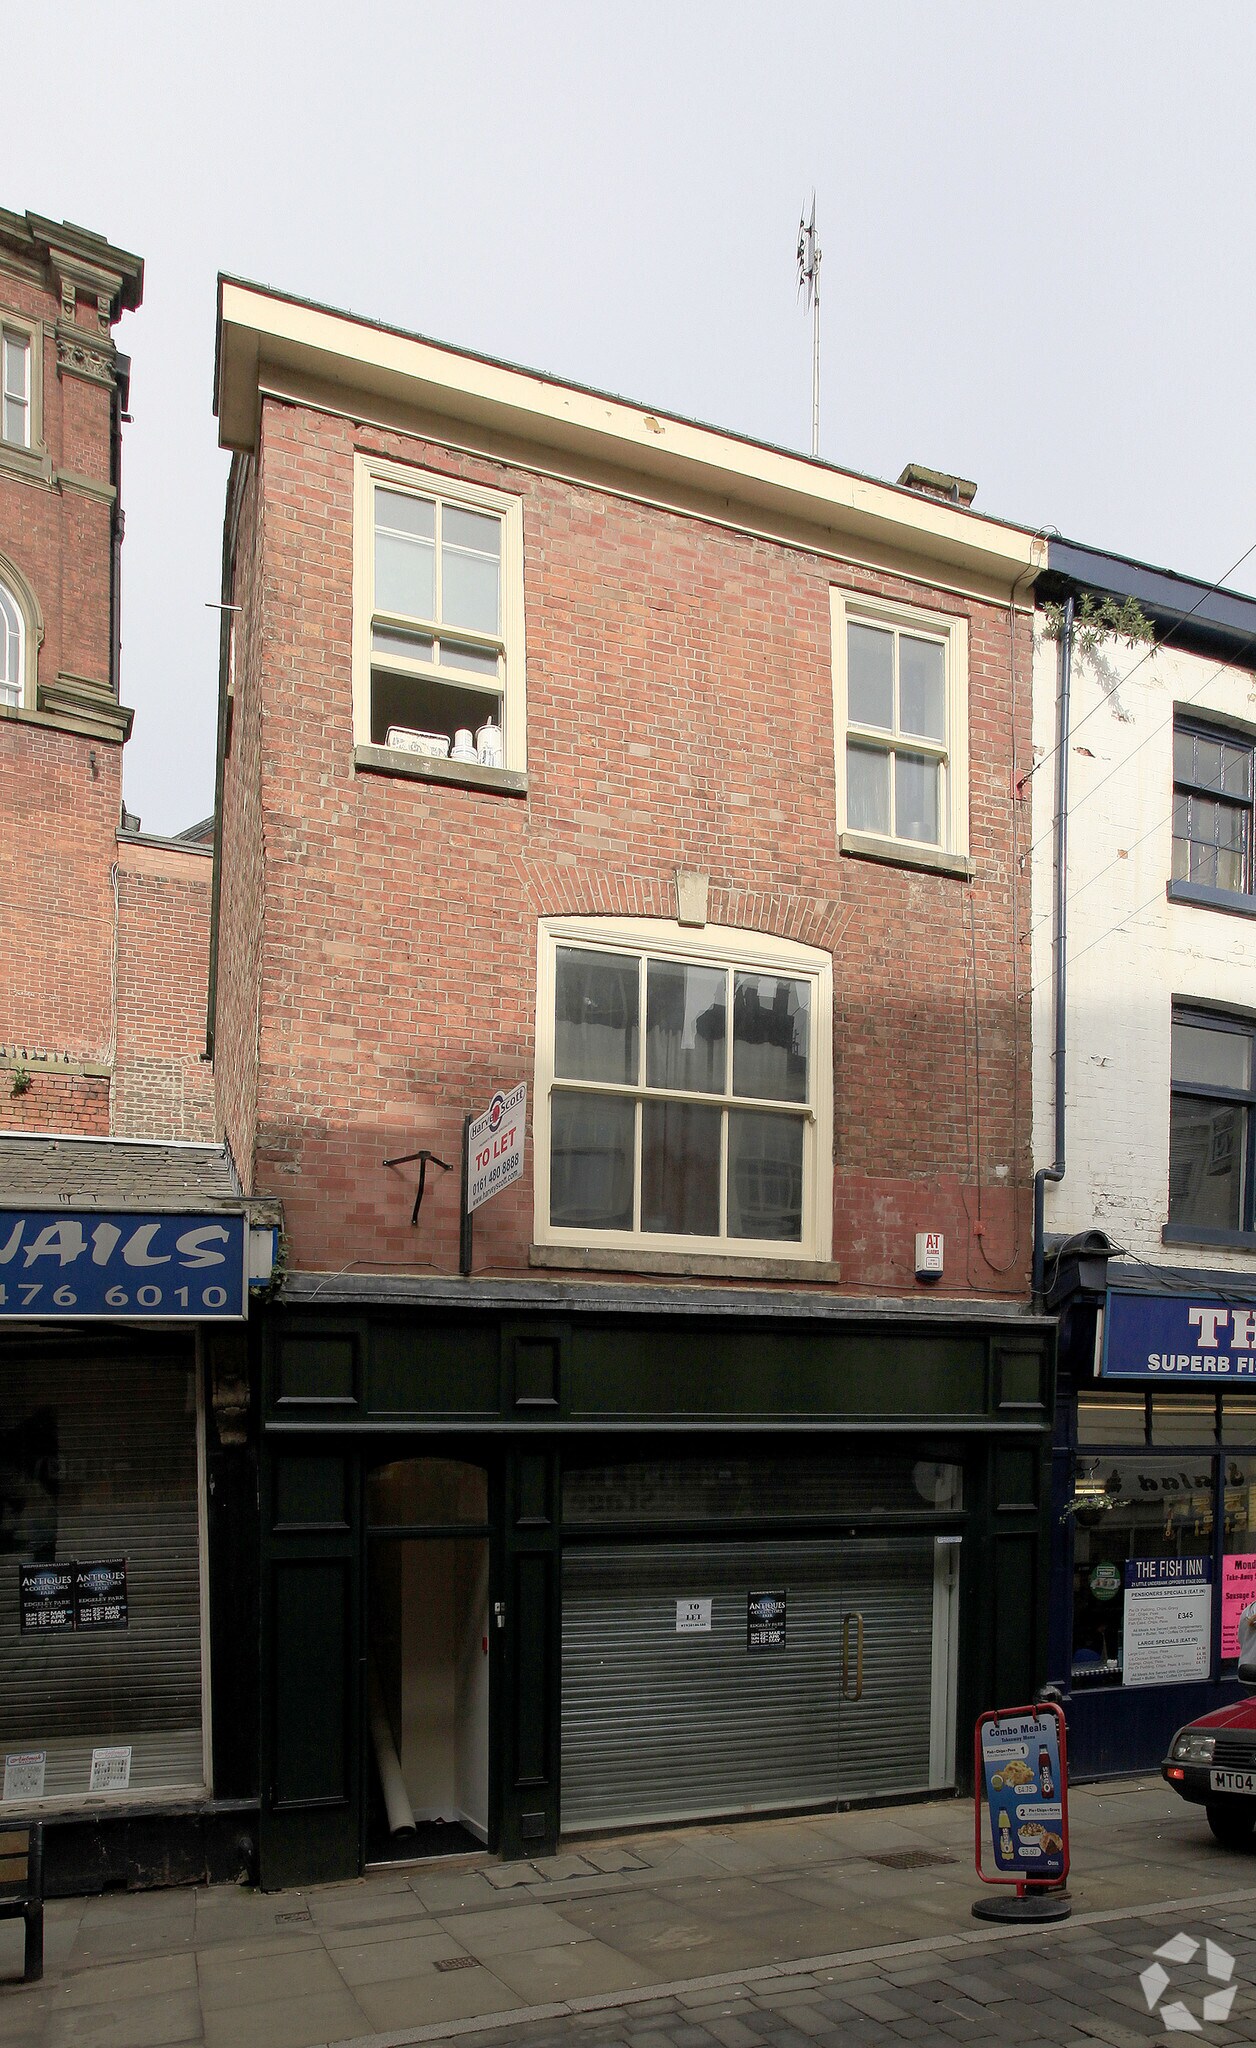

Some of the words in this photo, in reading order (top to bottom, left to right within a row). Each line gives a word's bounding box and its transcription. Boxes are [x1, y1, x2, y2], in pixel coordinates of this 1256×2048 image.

[472, 1108, 498, 1137] Harve
[500, 1089, 523, 1114] Scott
[475, 1147, 490, 1171] TO
[493, 1127, 517, 1159] LET
[472, 1175, 487, 1196] 0161
[488, 1166, 501, 1183] 480
[502, 1153, 519, 1175] 8888
[104, 1285, 228, 1308] 6010
[1148, 1353, 1230, 1373] SUPERB
[1237, 1357, 1256, 1373] FI
[1136, 1561, 1156, 1578] THE
[1160, 1560, 1182, 1577] FISH
[1186, 1559, 1203, 1576] INN
[22, 1576, 72, 1586] ANTIQUES
[76, 1572, 125, 1583] ANTIQUES
[83, 1580, 122, 1588] COLLECTORS
[1131, 1590, 1163, 1598] PENSIONERS
[1226, 1592, 1250, 1600] Sausage
[749, 1602, 786, 1610] ANTIQUES
[989, 1727, 1018, 1737] Combo
[1020, 1723, 1047, 1734] Meals
[1021, 1746, 1025, 1754] 1
